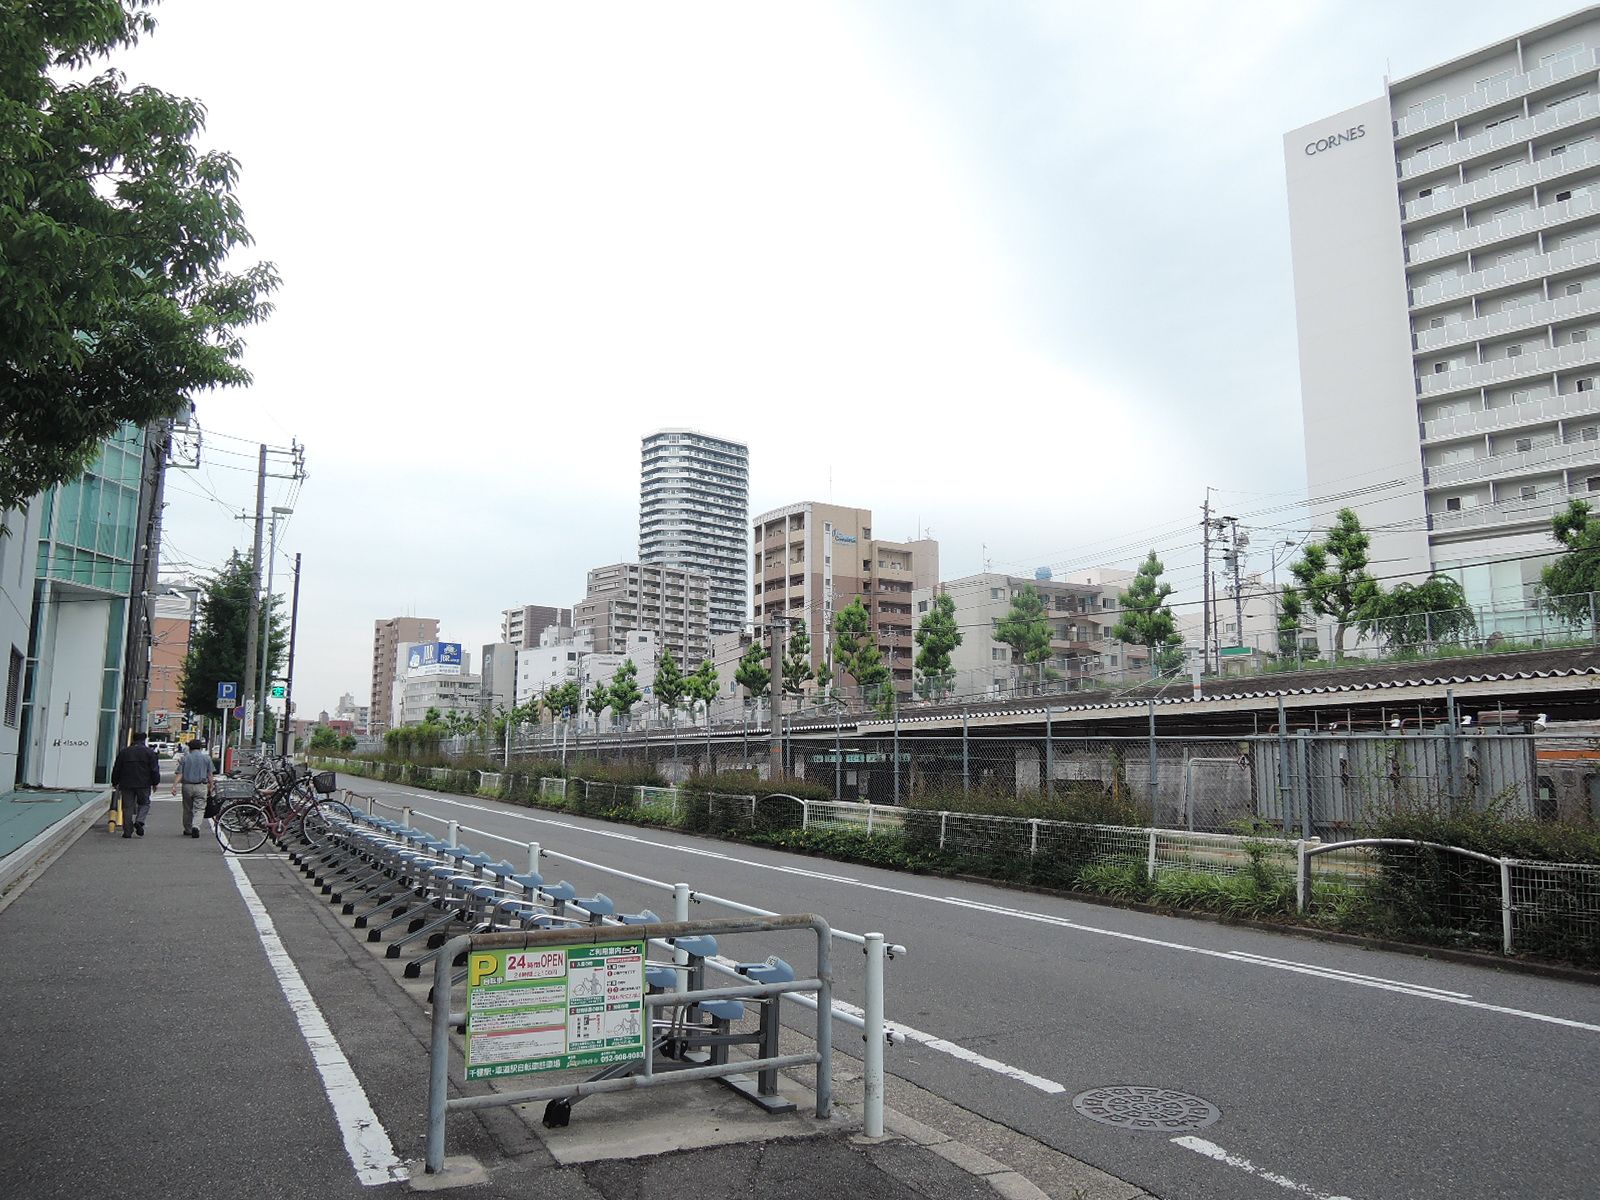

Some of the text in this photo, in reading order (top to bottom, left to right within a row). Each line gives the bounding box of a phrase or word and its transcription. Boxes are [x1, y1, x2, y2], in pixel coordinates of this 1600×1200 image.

[1304, 124, 1366, 156] CORNES
[222, 684, 233, 697] P
[471, 954, 498, 986] P
